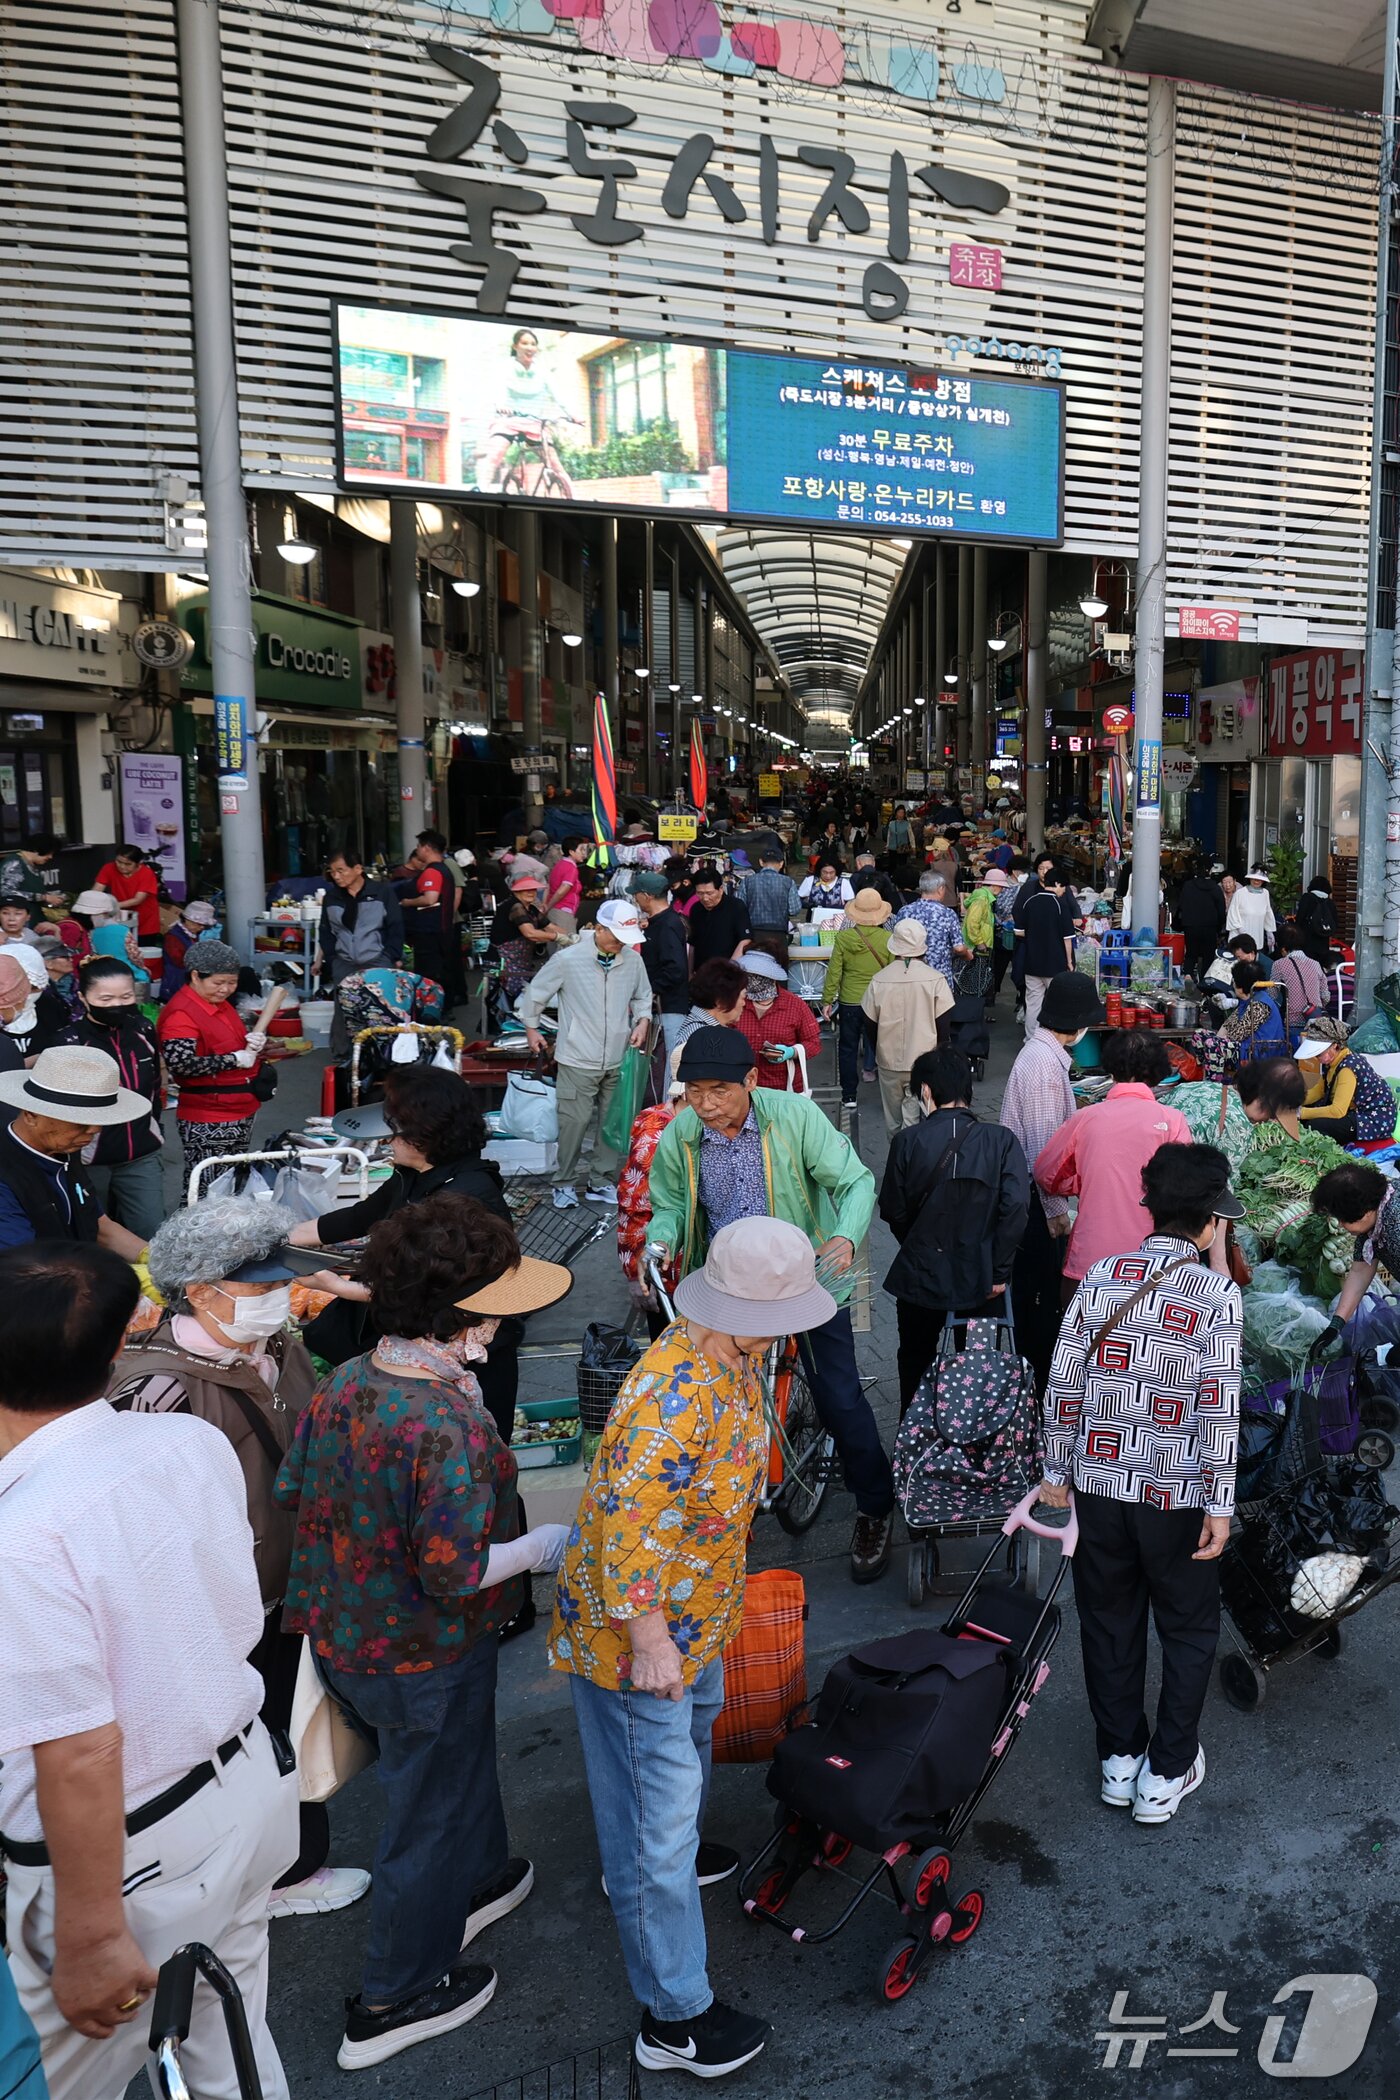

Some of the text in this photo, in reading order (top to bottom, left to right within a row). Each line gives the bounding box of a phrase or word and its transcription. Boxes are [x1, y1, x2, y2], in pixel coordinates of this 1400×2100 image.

[955, 247, 997, 267] 죽도
[953, 268, 997, 287] 시장
[1013, 362, 1040, 375] 포항시
[779, 386, 842, 406] (죽도시장
[845, 395, 894, 414] 3분거리
[907, 399, 962, 420] 중앙상가
[966, 405, 1011, 427] 실개천)
[838, 429, 955, 458] 30분 무료주차
[836, 505, 864, 521] 문의
[874, 510, 954, 527] 054-255-1033
[980, 499, 1007, 515] 환영
[1182, 609, 1196, 619] 공공
[1182, 618, 1209, 628] 와이파이
[1182, 626, 1216, 637] 서비스지역
[268, 632, 351, 679] Crocodile
[943, 694, 954, 702] 12
[1270, 650, 1362, 745] 개풍약국
[1141, 745, 1150, 769] 이곳에
[1141, 769, 1150, 800] 현수막을
[1150, 777, 1158, 800] 마세요
